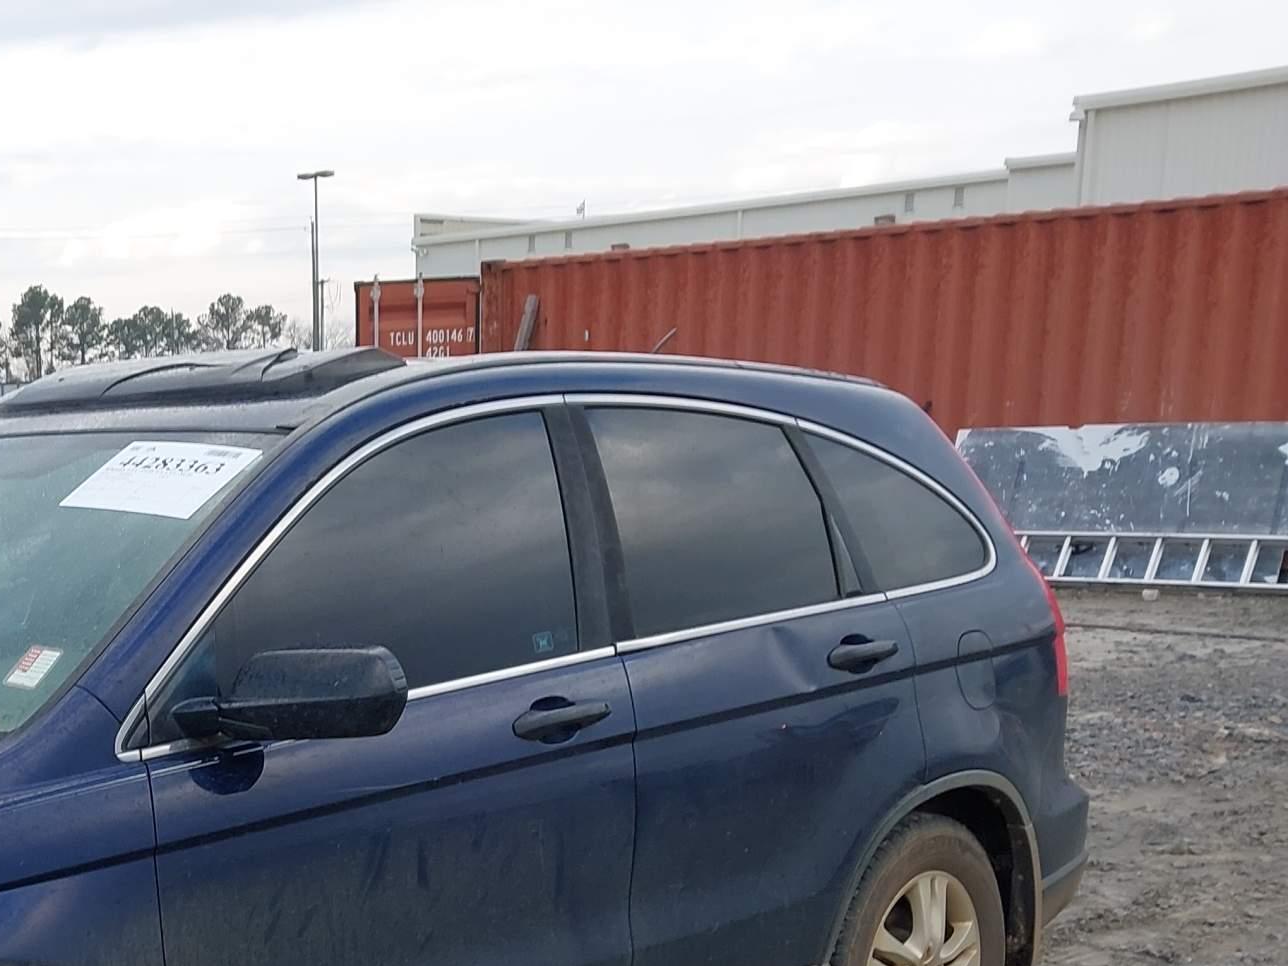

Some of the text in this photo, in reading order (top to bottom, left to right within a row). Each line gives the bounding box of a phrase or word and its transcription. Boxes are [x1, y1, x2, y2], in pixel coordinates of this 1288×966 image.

[390, 330, 415, 346] TCLU
[426, 328, 463, 344] 400146
[119, 455, 225, 474] 44283363
